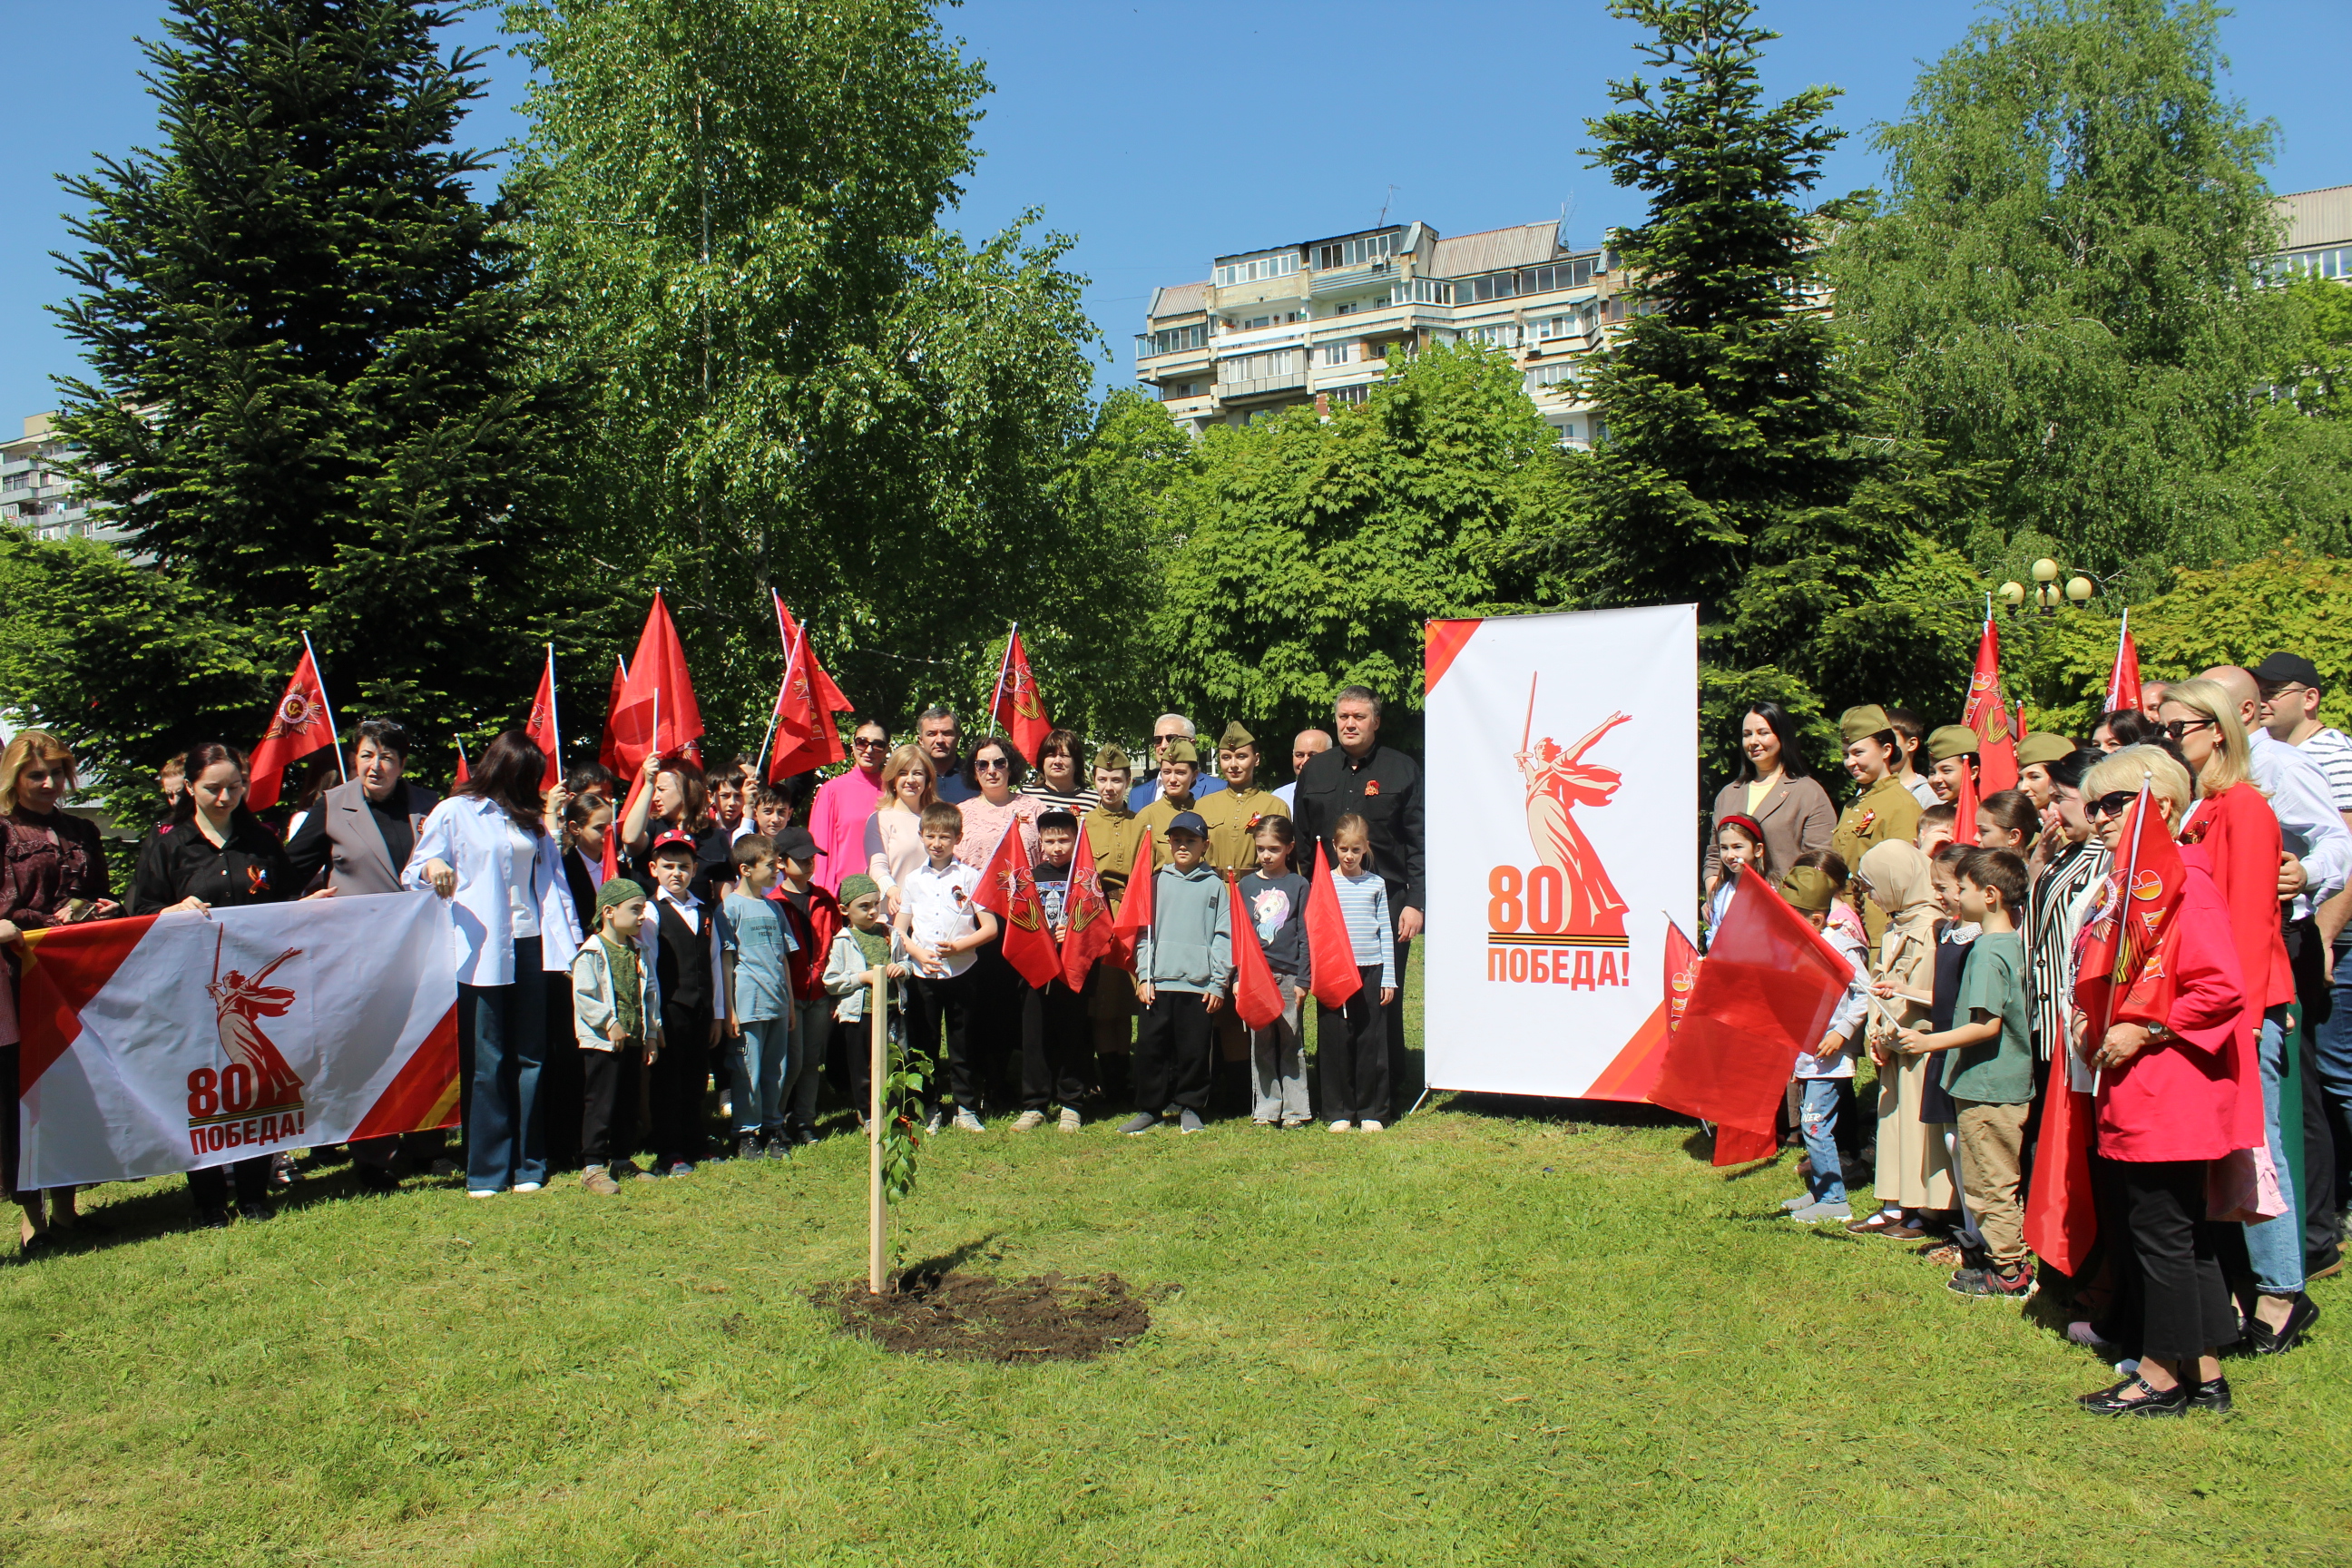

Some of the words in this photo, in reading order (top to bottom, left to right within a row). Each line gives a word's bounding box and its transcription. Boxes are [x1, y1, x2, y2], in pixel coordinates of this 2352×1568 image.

[1488, 865, 1563, 934] 80
[2131, 869, 2163, 901] 9
[1488, 947, 1630, 992] ПОБЕДА!
[187, 1063, 251, 1118] 80
[189, 1111, 305, 1156] ПОБЕДА!
